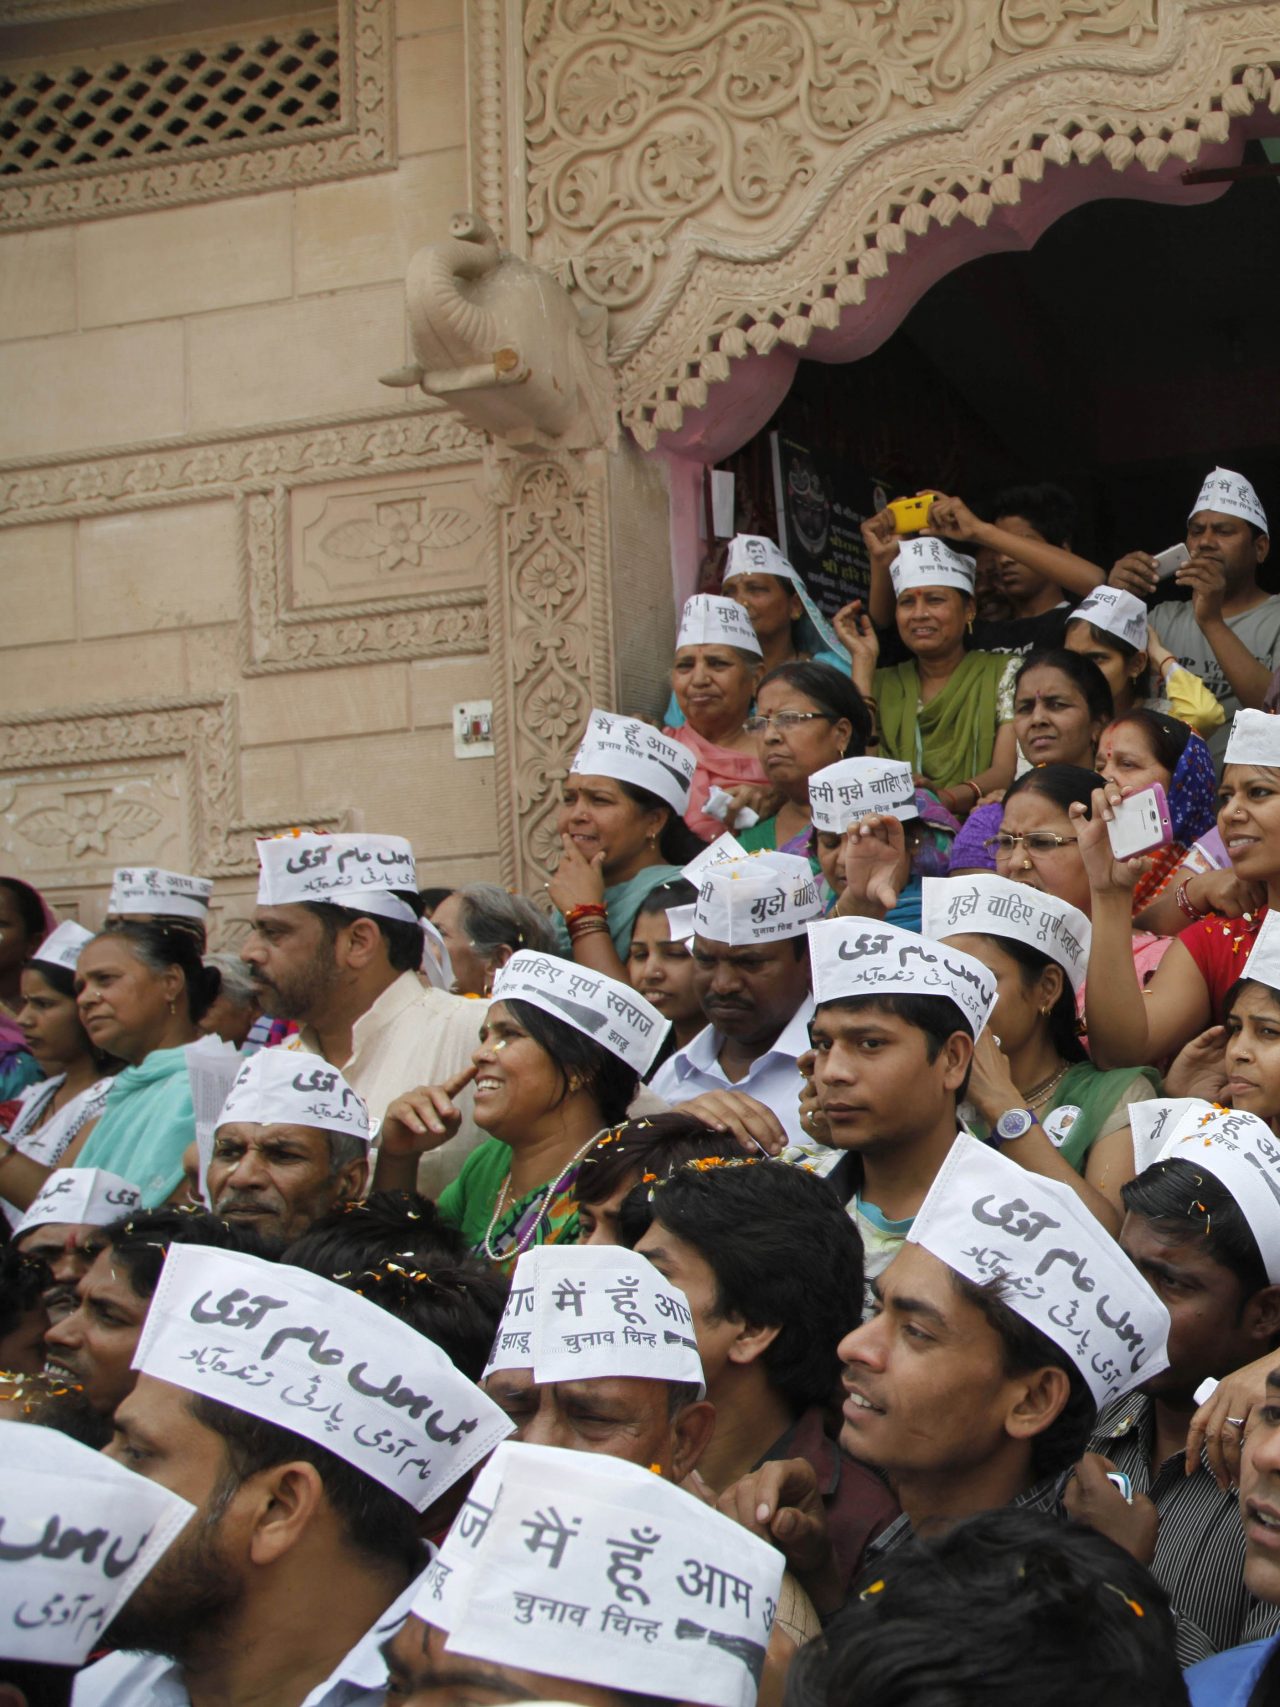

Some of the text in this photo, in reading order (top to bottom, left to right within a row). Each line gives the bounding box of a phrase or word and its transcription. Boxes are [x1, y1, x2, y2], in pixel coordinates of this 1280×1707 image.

[595, 718, 677, 762] मैं हूँ आम
[808, 781, 834, 802] दमी
[838, 778, 863, 805] मुझे
[868, 772, 902, 795] चाहिए
[751, 887, 788, 924] मुझे
[948, 887, 981, 924] मुझे
[987, 893, 1035, 926] चाहिए
[1036, 911, 1066, 941] पूर्ण
[838, 933, 895, 961] آدمی
[898, 945, 938, 967] عام
[512, 958, 655, 1038] चाहिए पूर्ण स्वराज
[1222, 1113, 1259, 1140] हूँ
[971, 1194, 1061, 1242] آدمی
[1035, 1248, 1096, 1293] عام
[190, 1288, 288, 1330] آدمی
[552, 1278, 587, 1317] मैं
[605, 1275, 647, 1326] हूँ
[261, 1326, 345, 1361] عام
[502, 1331, 532, 1355] झाड़ू
[561, 1326, 657, 1355] चुनाव चिन्ह
[1048, 1300, 1090, 1355] پارٹی
[280, 1374, 345, 1432] پارٹی
[347, 1361, 434, 1420] ہوں
[353, 1424, 418, 1458] آدمی
[397, 1457, 433, 1481] عام
[519, 1505, 583, 1569] मैं
[605, 1526, 662, 1607] हूँ
[676, 1557, 754, 1619] आम
[12, 1593, 96, 1628] آدمی
[512, 1590, 664, 1644] चुनाव चिन्ह
